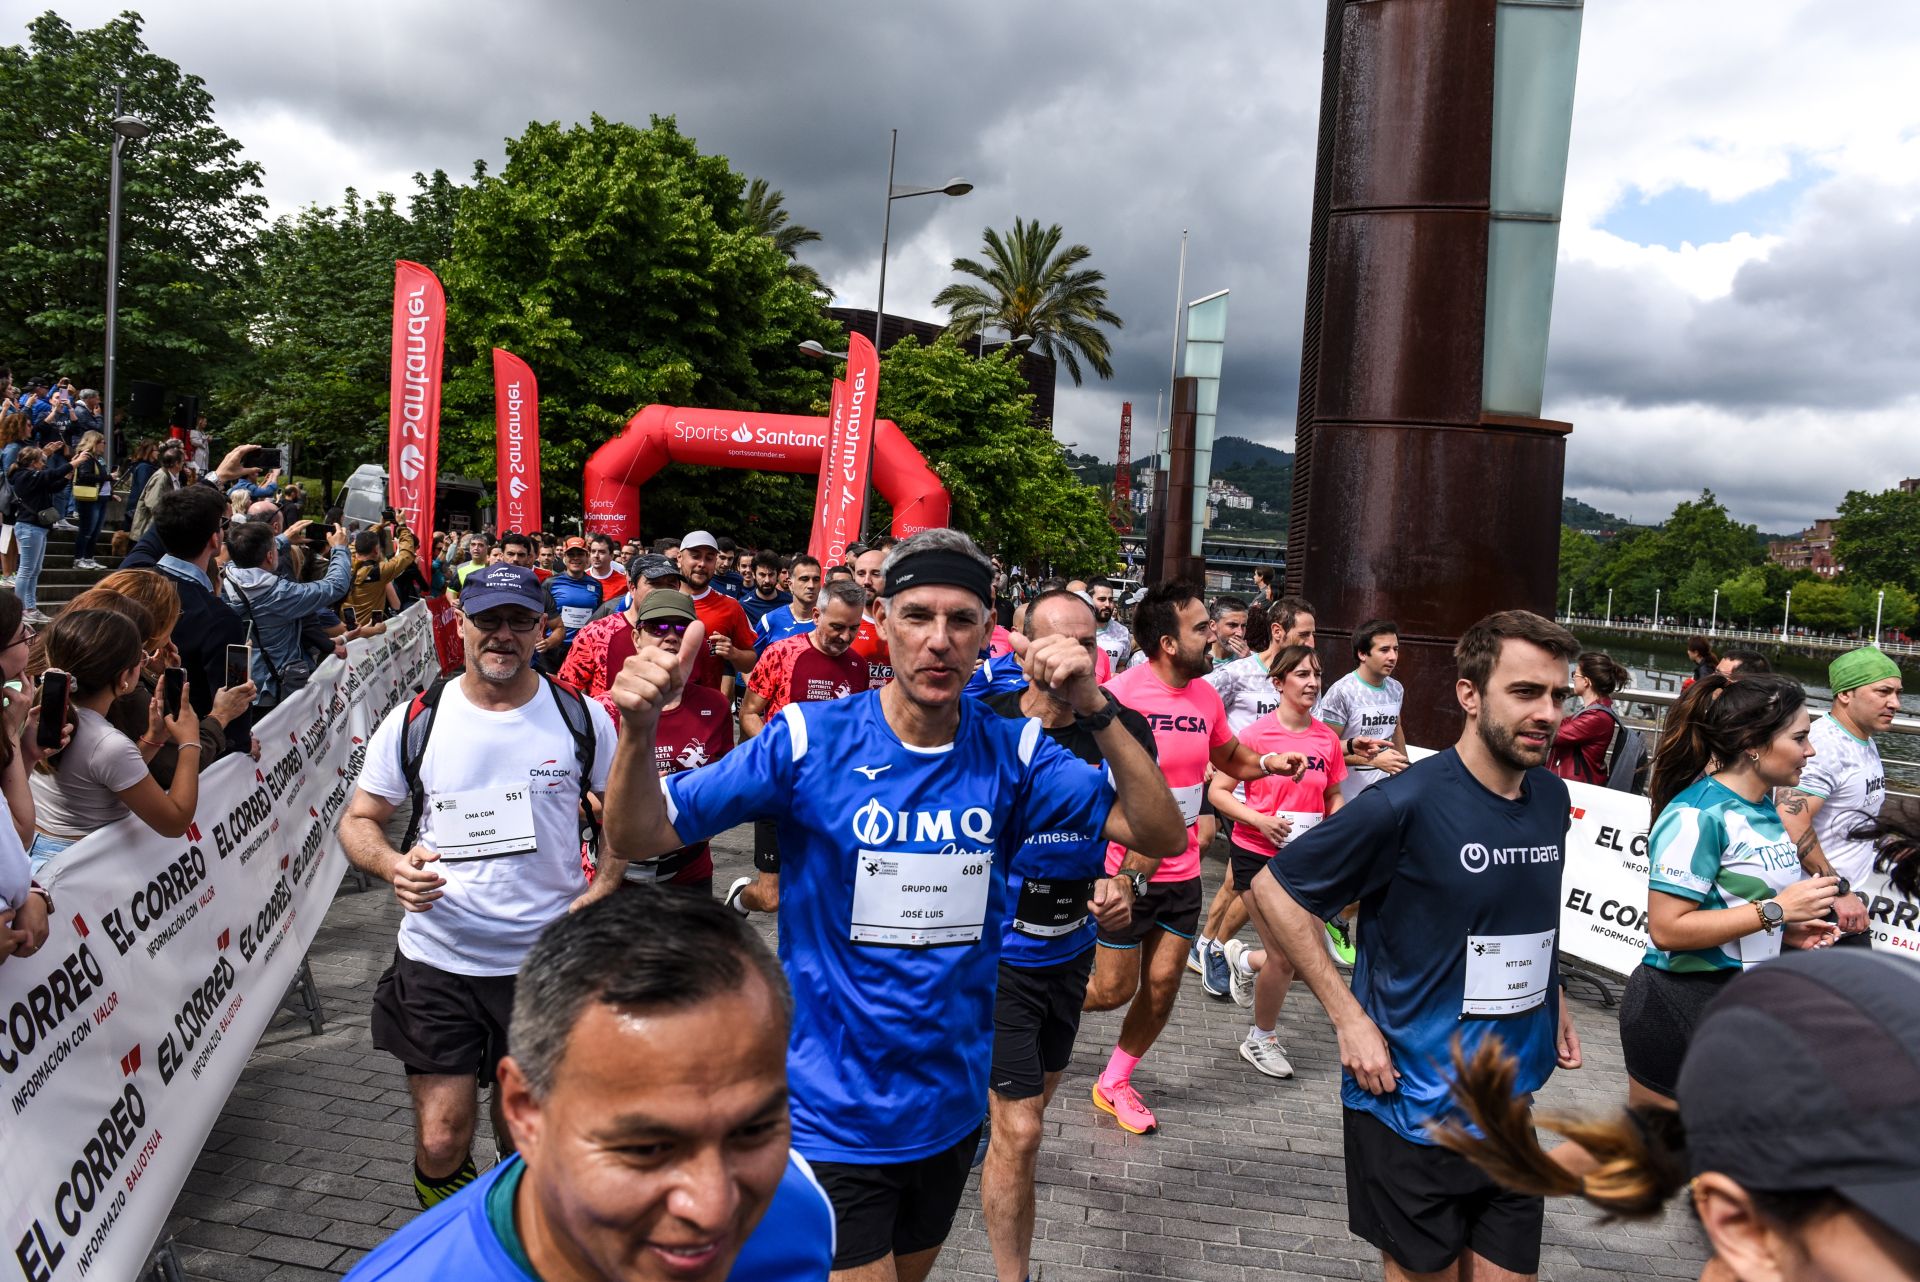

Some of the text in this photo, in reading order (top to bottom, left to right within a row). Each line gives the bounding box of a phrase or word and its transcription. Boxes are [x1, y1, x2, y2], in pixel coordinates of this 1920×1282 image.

[674, 421, 728, 442] Sports
[728, 449, 786, 458] sportssantander.es
[590, 498, 614, 509] Sports
[588, 512, 627, 521] Santander
[487, 571, 504, 579] CMA
[1147, 714, 1207, 734] TECSA
[529, 769, 551, 777] CMA
[505, 791, 522, 801] 551
[212, 822, 235, 860] EL
[229, 785, 272, 844] CORREO
[896, 807, 995, 844] IMQ
[468, 828, 496, 838] IGNACIO
[1594, 825, 1650, 857] EL C
[1493, 848, 1527, 865] NTT
[962, 865, 983, 876] 608
[1622, 861, 1650, 875] INFOR
[901, 884, 948, 893] GRUPO IMQ
[101, 845, 207, 957] EL CORREO
[1565, 888, 1595, 915] EL
[1855, 890, 1920, 932] RR
[146, 885, 216, 961] INFORMACIÓN CON VALOR
[240, 874, 292, 963] EL CORREO
[900, 908, 944, 919] JOSÉ LUIS
[1518, 959, 1532, 967] DATA
[1508, 981, 1528, 990] XABIER
[158, 955, 235, 1087] EL CORREO
[190, 992, 244, 1081] INFORMAZIO BALIOTSUA
[11, 991, 119, 1116] INFORMACIÓN CON VALOR
[15, 1083, 146, 1282] EL CORREO
[77, 1128, 163, 1277] INFORMAZIO BALIOTSUA
